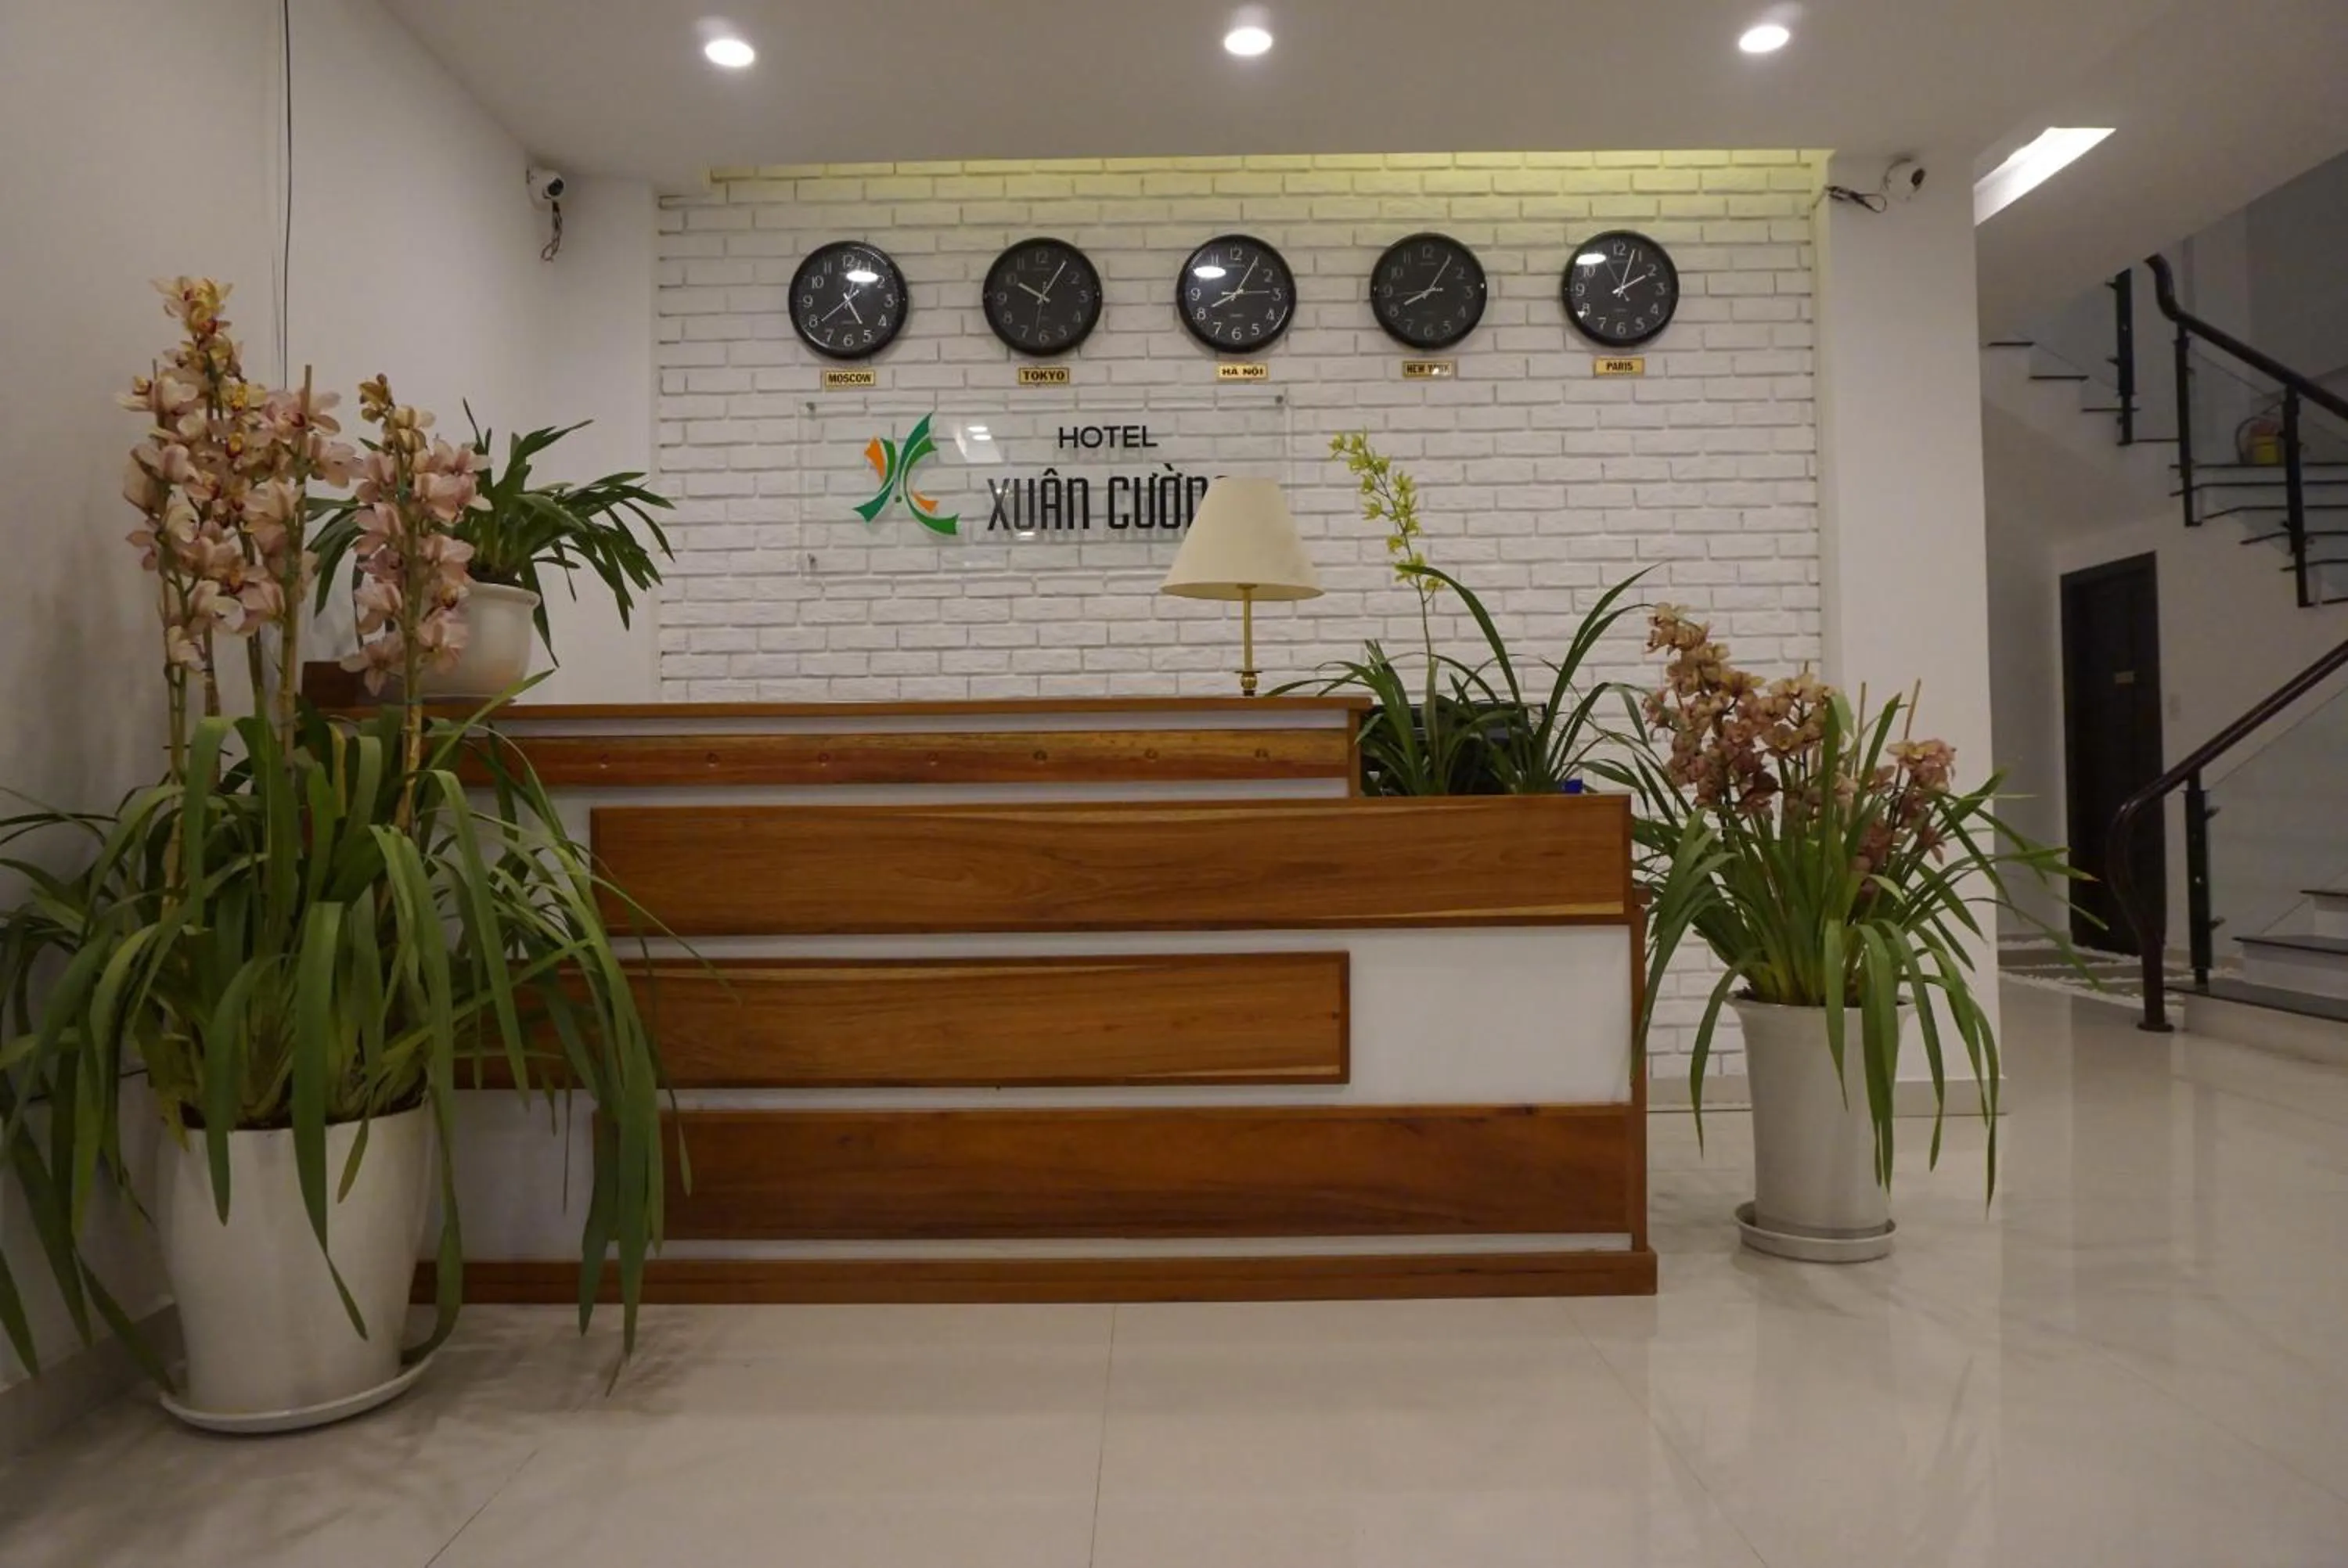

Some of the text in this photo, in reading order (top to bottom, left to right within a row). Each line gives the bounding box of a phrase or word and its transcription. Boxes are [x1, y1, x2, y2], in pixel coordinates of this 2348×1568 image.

[1230, 248, 1242, 260] 12
[1423, 245, 1434, 258] 12
[1613, 243, 1626, 256] 12
[843, 255, 854, 268] 12
[1035, 251, 1048, 264] 12
[1403, 251, 1410, 264] 11
[824, 262, 832, 274] 11
[1392, 268, 1403, 279] 10
[1456, 266, 1464, 279] 2
[1583, 266, 1595, 277] 10
[1647, 264, 1656, 276] 2
[812, 275, 823, 289] 10
[877, 275, 885, 289] 2
[1071, 272, 1079, 284] 2
[1263, 269, 1273, 282] 2
[1190, 288, 1201, 300] 9
[1273, 288, 1281, 300] 3
[1383, 285, 1392, 297] 9
[1464, 286, 1473, 299] 3
[1576, 284, 1585, 296] 9
[1655, 283, 1665, 295] 3
[803, 295, 813, 307] 9
[884, 294, 894, 307] 3
[997, 292, 1007, 305] 9
[1079, 290, 1088, 303] 3
[1197, 307, 1206, 320] 8
[1266, 308, 1274, 319] 4
[1389, 304, 1399, 317] 8
[1458, 306, 1466, 318] 4
[1650, 304, 1658, 315] 4
[809, 315, 818, 327] 8
[878, 315, 886, 326] 4
[1003, 311, 1012, 325] 8
[1073, 311, 1081, 322] 4
[1597, 317, 1606, 329] 7
[1213, 322, 1222, 335] 7
[1251, 324, 1260, 335] 5
[1424, 324, 1433, 337] 6
[1443, 321, 1452, 333] 5
[1616, 322, 1626, 335] 6
[1635, 318, 1644, 330] 5
[824, 329, 834, 343] 7
[863, 330, 873, 343] 5
[1021, 325, 1028, 338] 7
[1039, 330, 1050, 343] 6
[1058, 326, 1067, 338] 5
[1232, 327, 1241, 340] 6
[843, 334, 854, 347] 6
[1406, 364, 1424, 373] NEW
[1606, 361, 1633, 371] PARIS
[1023, 370, 1064, 380] TOKYO
[1058, 425, 1158, 448] HOTEL
[987, 463, 1228, 530] XUÂN CƯỜN
